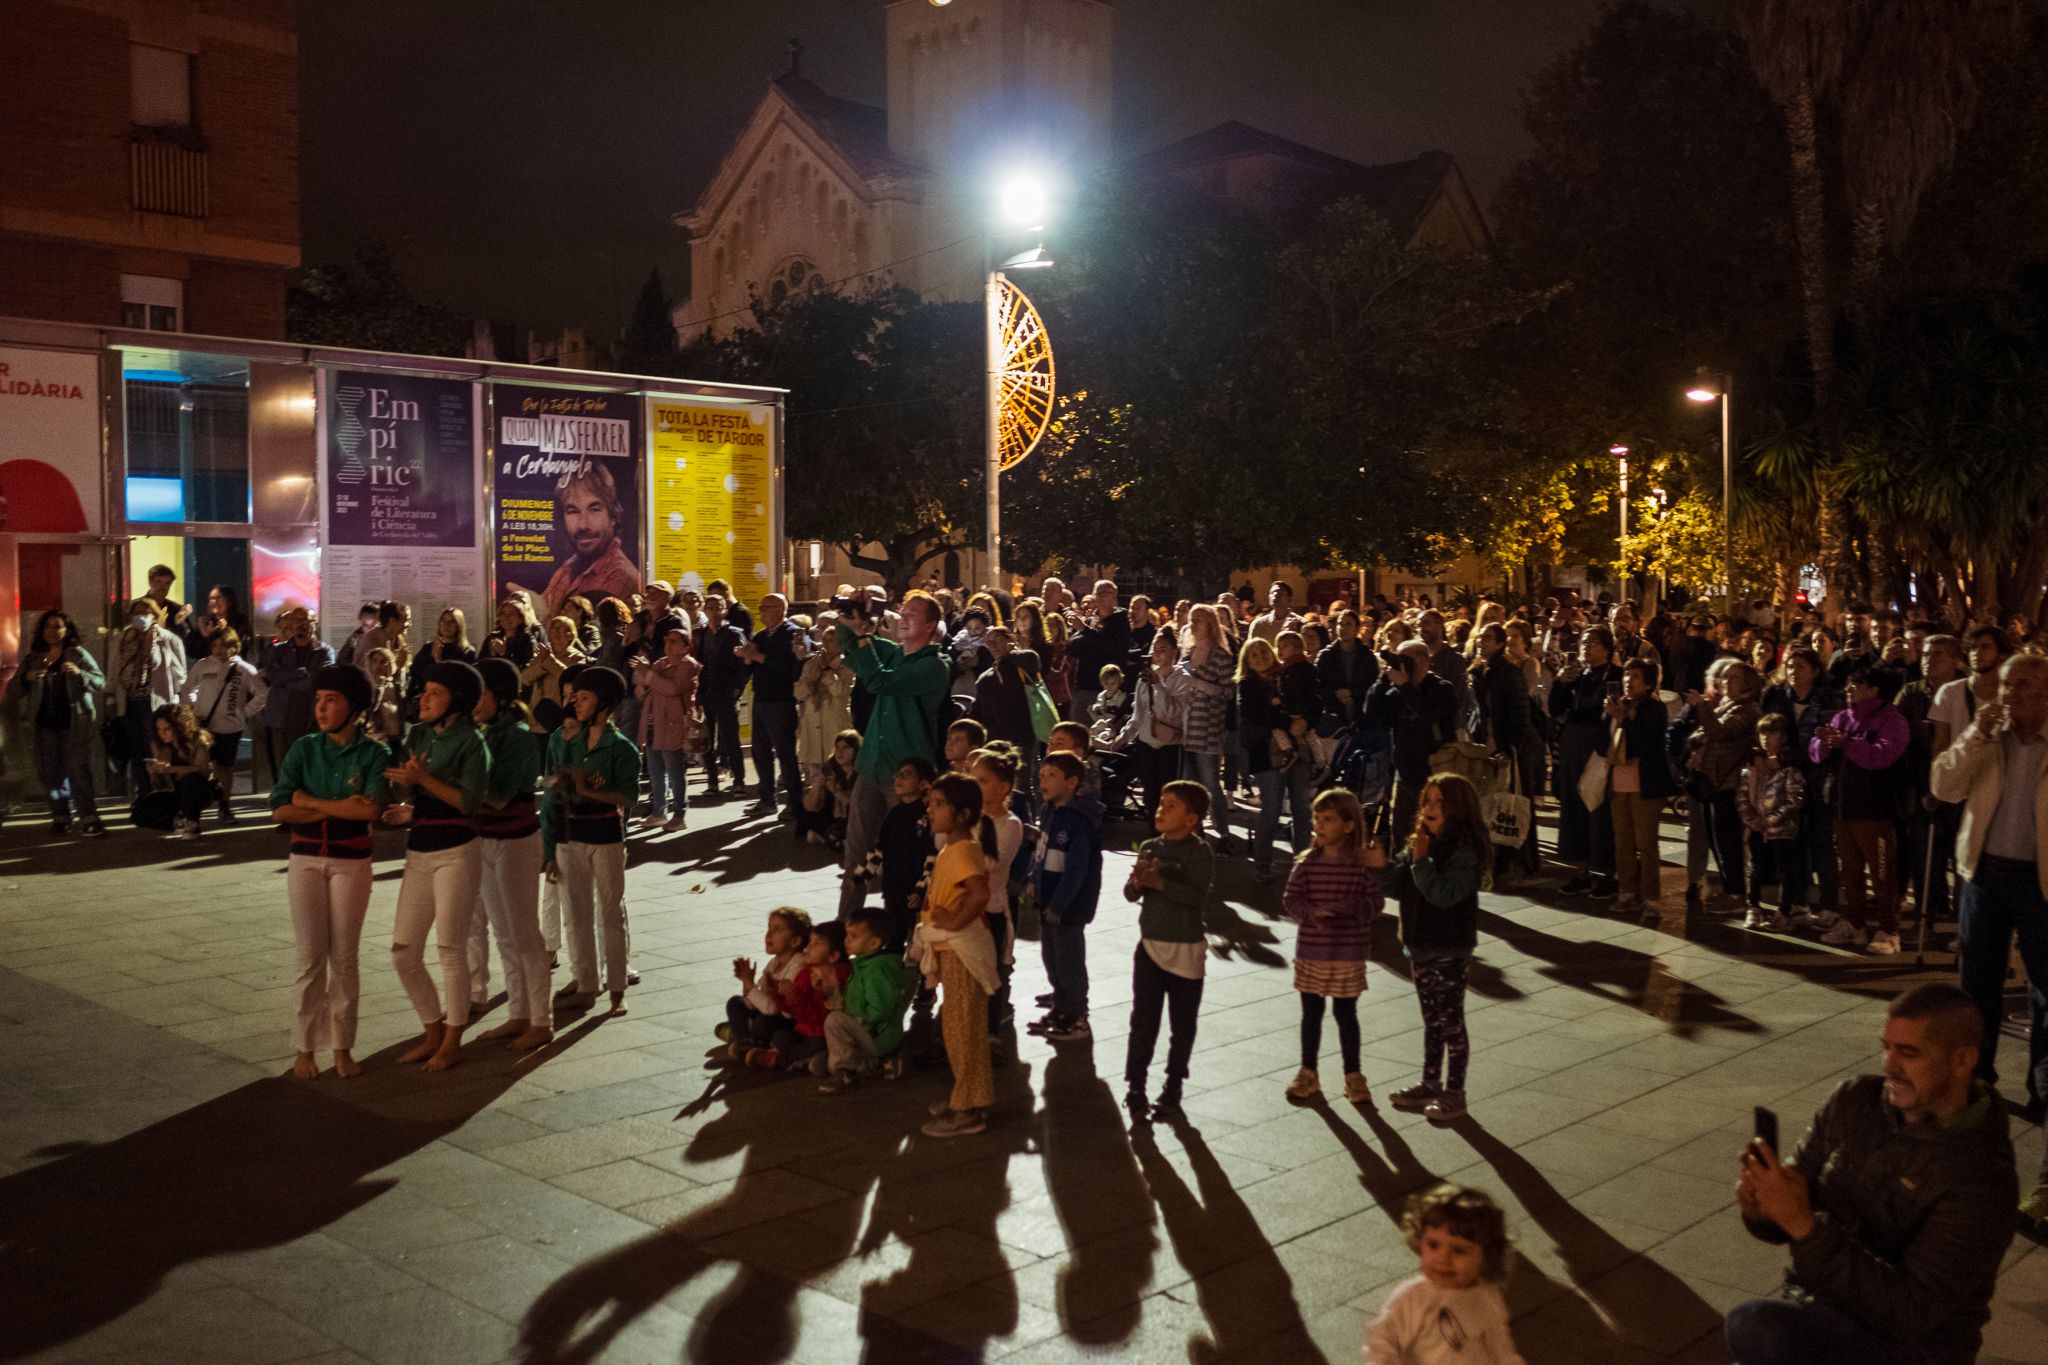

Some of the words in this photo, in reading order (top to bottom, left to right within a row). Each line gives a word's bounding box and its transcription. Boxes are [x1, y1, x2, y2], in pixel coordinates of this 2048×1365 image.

[368, 388, 421, 420] Em
[658, 409, 692, 425] TOTA
[694, 412, 709, 427] LA
[712, 413, 750, 430] FESTA
[369, 420, 398, 460] pí
[505, 418, 537, 443] QUIM
[543, 418, 627, 454] MASFERRER
[698, 428, 714, 443] DE
[717, 430, 765, 447] TARDOR
[369, 456, 411, 486] ric
[502, 461, 512, 475] a
[516, 451, 593, 489] Cerdanyola
[371, 495, 410, 507] Festival
[501, 499, 554, 509] DIUMENGE
[386, 507, 437, 519] Literatura
[518, 510, 554, 521] NOVEMBRE
[510, 522, 526, 530] LES
[502, 544, 513, 552] de
[515, 544, 524, 552] la
[525, 544, 550, 554] Plaça
[502, 553, 523, 562] Sant
[524, 553, 555, 562] Ramon
